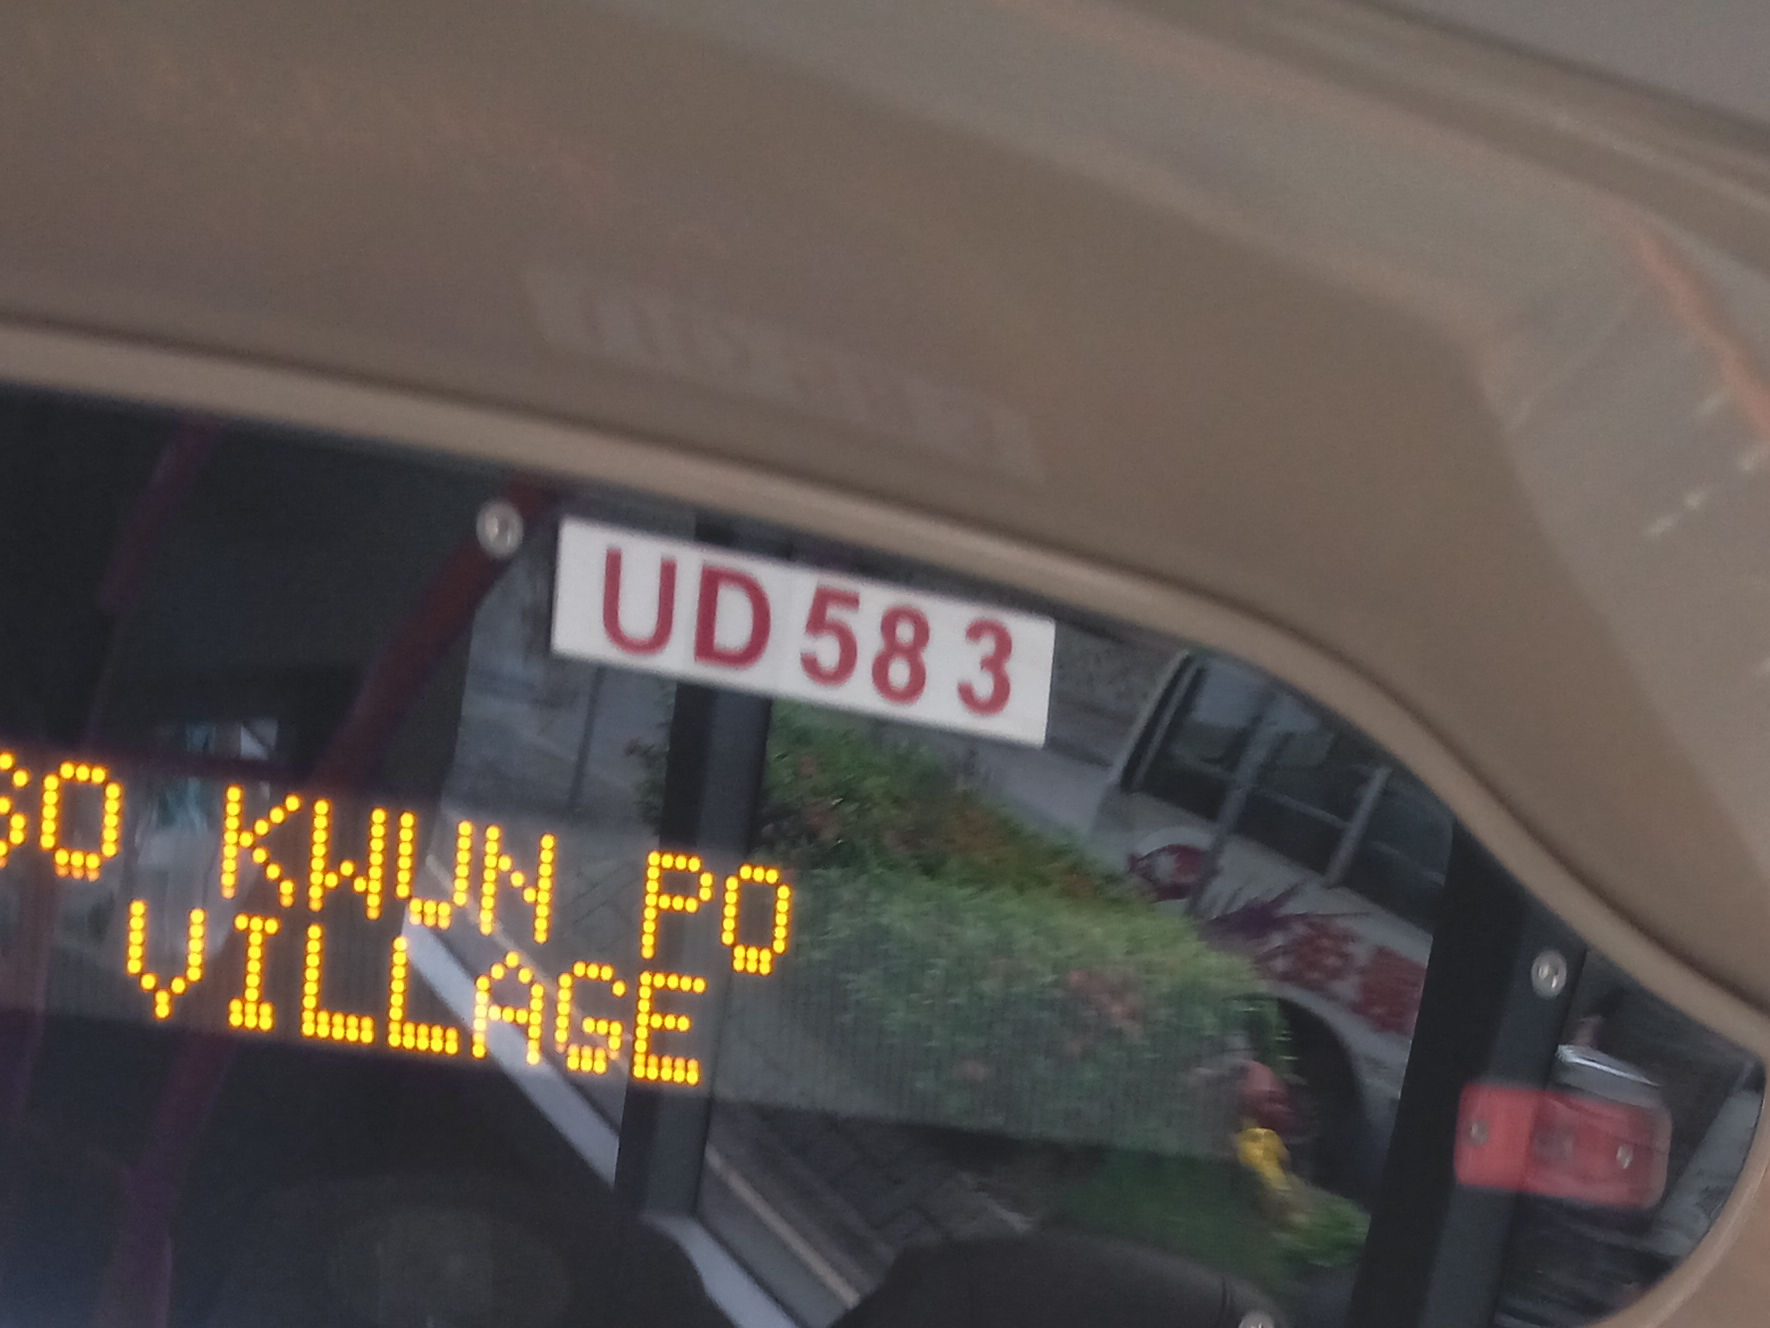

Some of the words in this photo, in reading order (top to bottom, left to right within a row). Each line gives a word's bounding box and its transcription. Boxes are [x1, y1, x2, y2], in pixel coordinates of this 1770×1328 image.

[220, 784, 556, 943] KWUN
[643, 850, 794, 974] PO
[127, 899, 707, 1087] VILLAGE
